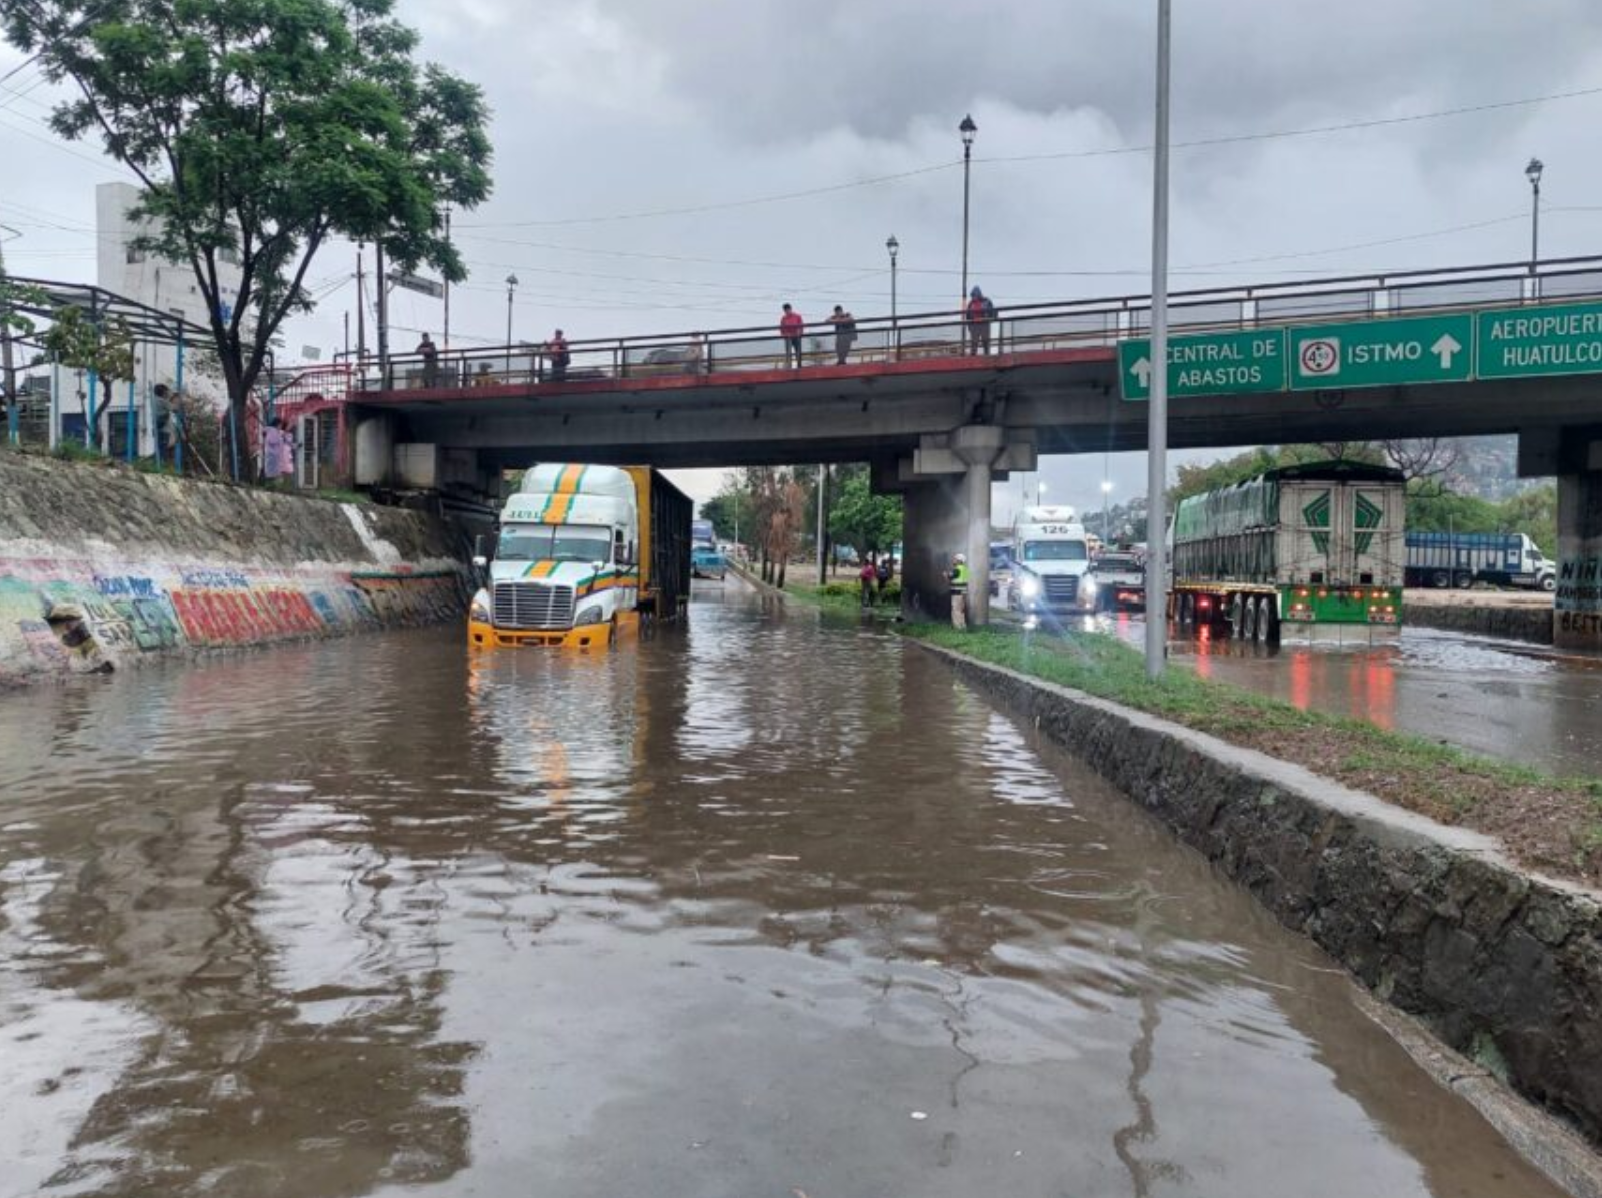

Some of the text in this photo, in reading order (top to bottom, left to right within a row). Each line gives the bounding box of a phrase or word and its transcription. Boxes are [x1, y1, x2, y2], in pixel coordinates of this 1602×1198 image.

[1252, 339, 1277, 358] DE
[1347, 341, 1422, 364] ISTMO
[1503, 341, 1602, 367] HUATULCO
[1177, 366, 1262, 387] ABASTOS
[1040, 525, 1069, 534] 126
